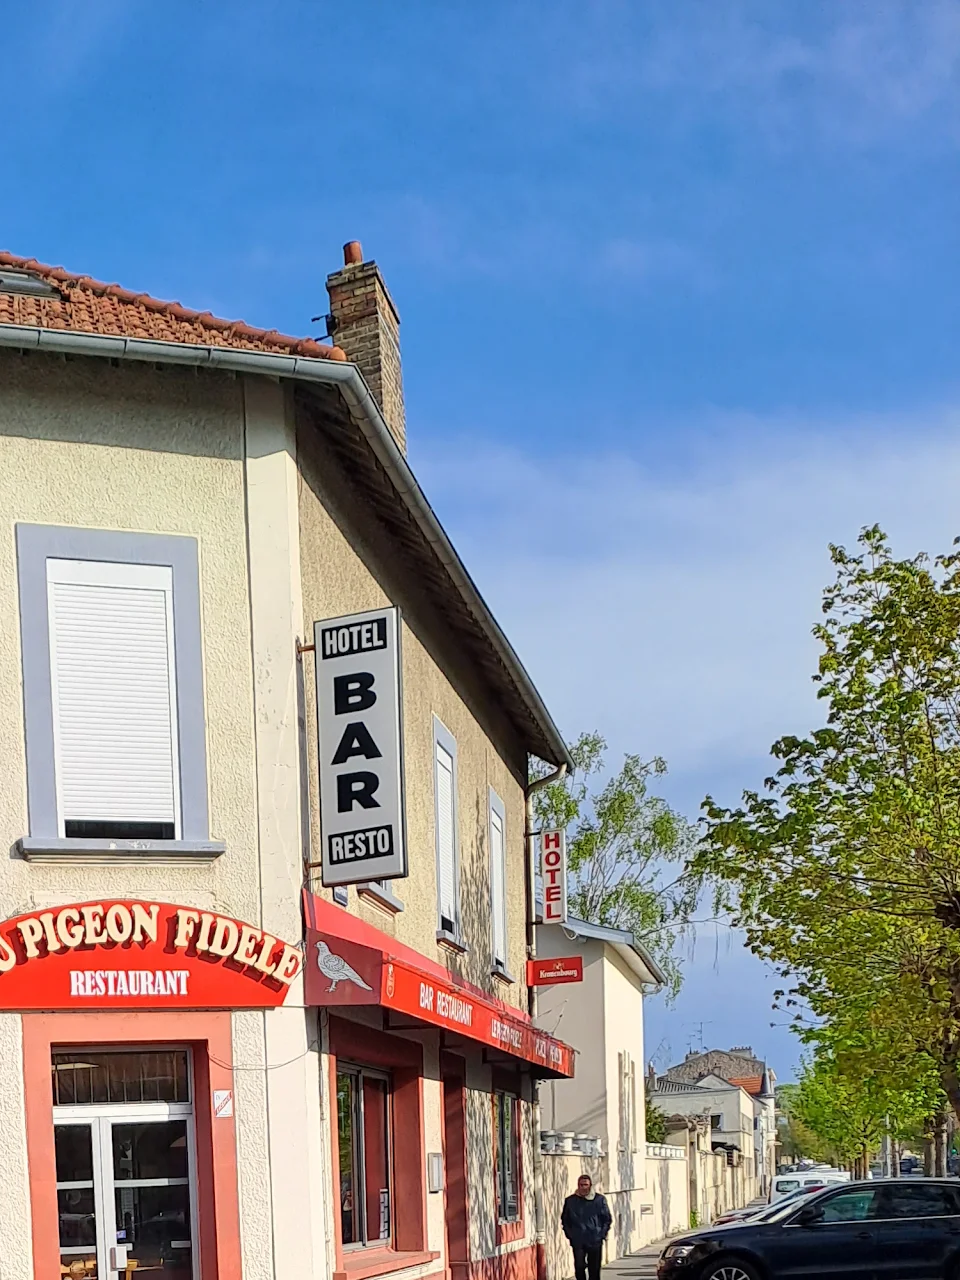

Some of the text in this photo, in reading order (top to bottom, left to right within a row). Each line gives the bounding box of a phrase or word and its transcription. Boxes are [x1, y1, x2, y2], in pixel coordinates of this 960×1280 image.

[325, 621, 384, 656] HOTEL
[330, 671, 383, 814] BAR
[331, 828, 390, 863] RESTO
[544, 832, 561, 919] HOTEL
[16, 903, 161, 959] PIGEON
[173, 908, 303, 986] FIDELE
[69, 969, 190, 997] RESTAURANT
[420, 982, 473, 1027] BAR RESTAURANT
